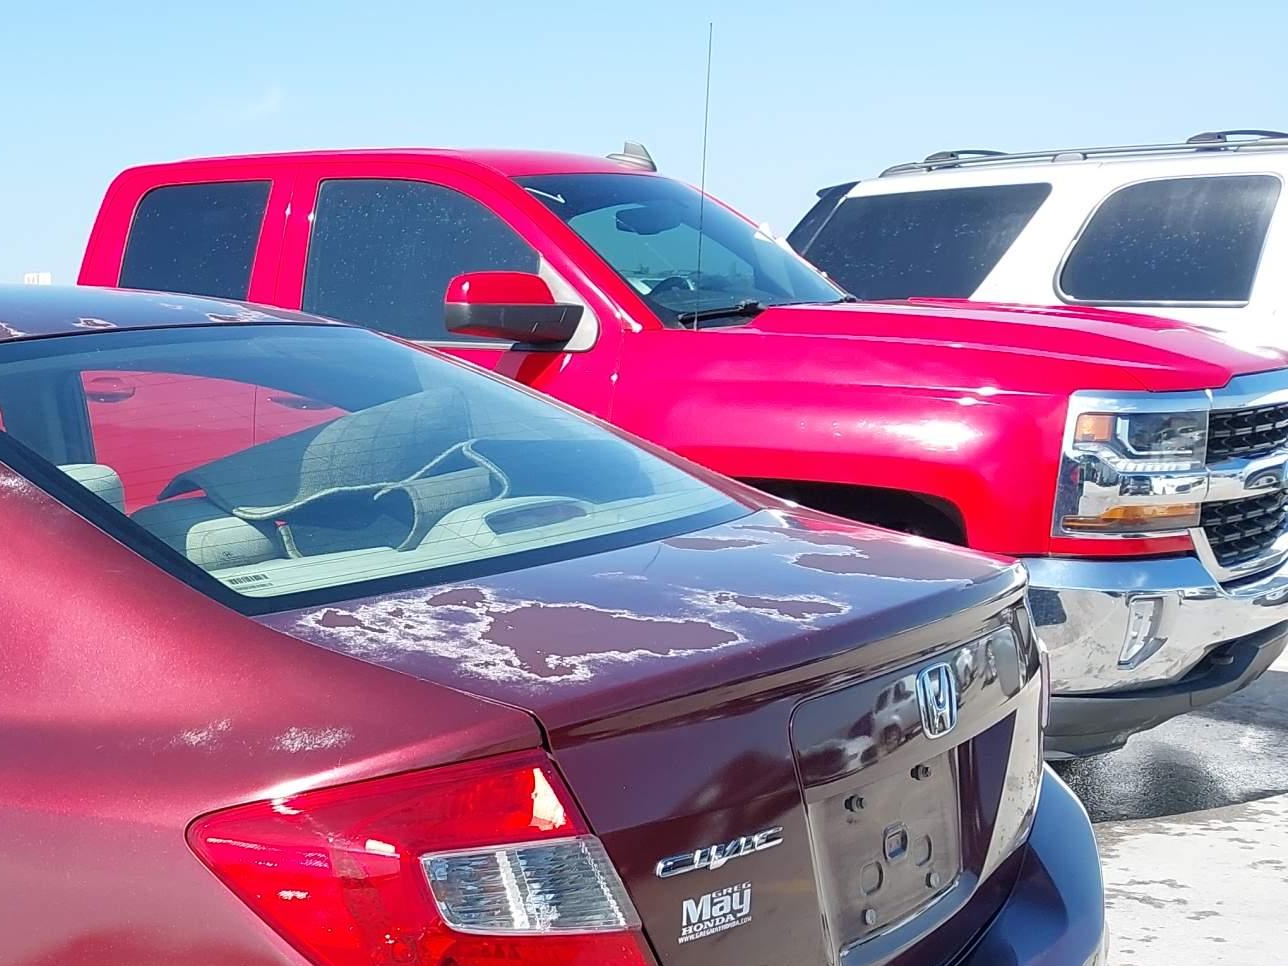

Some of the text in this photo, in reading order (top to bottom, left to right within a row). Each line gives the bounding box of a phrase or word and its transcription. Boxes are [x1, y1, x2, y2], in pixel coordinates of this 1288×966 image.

[655, 826, 784, 878] CIVIC
[711, 881, 752, 898] GREG
[682, 888, 752, 927] May
[681, 913, 736, 937] HONDA
